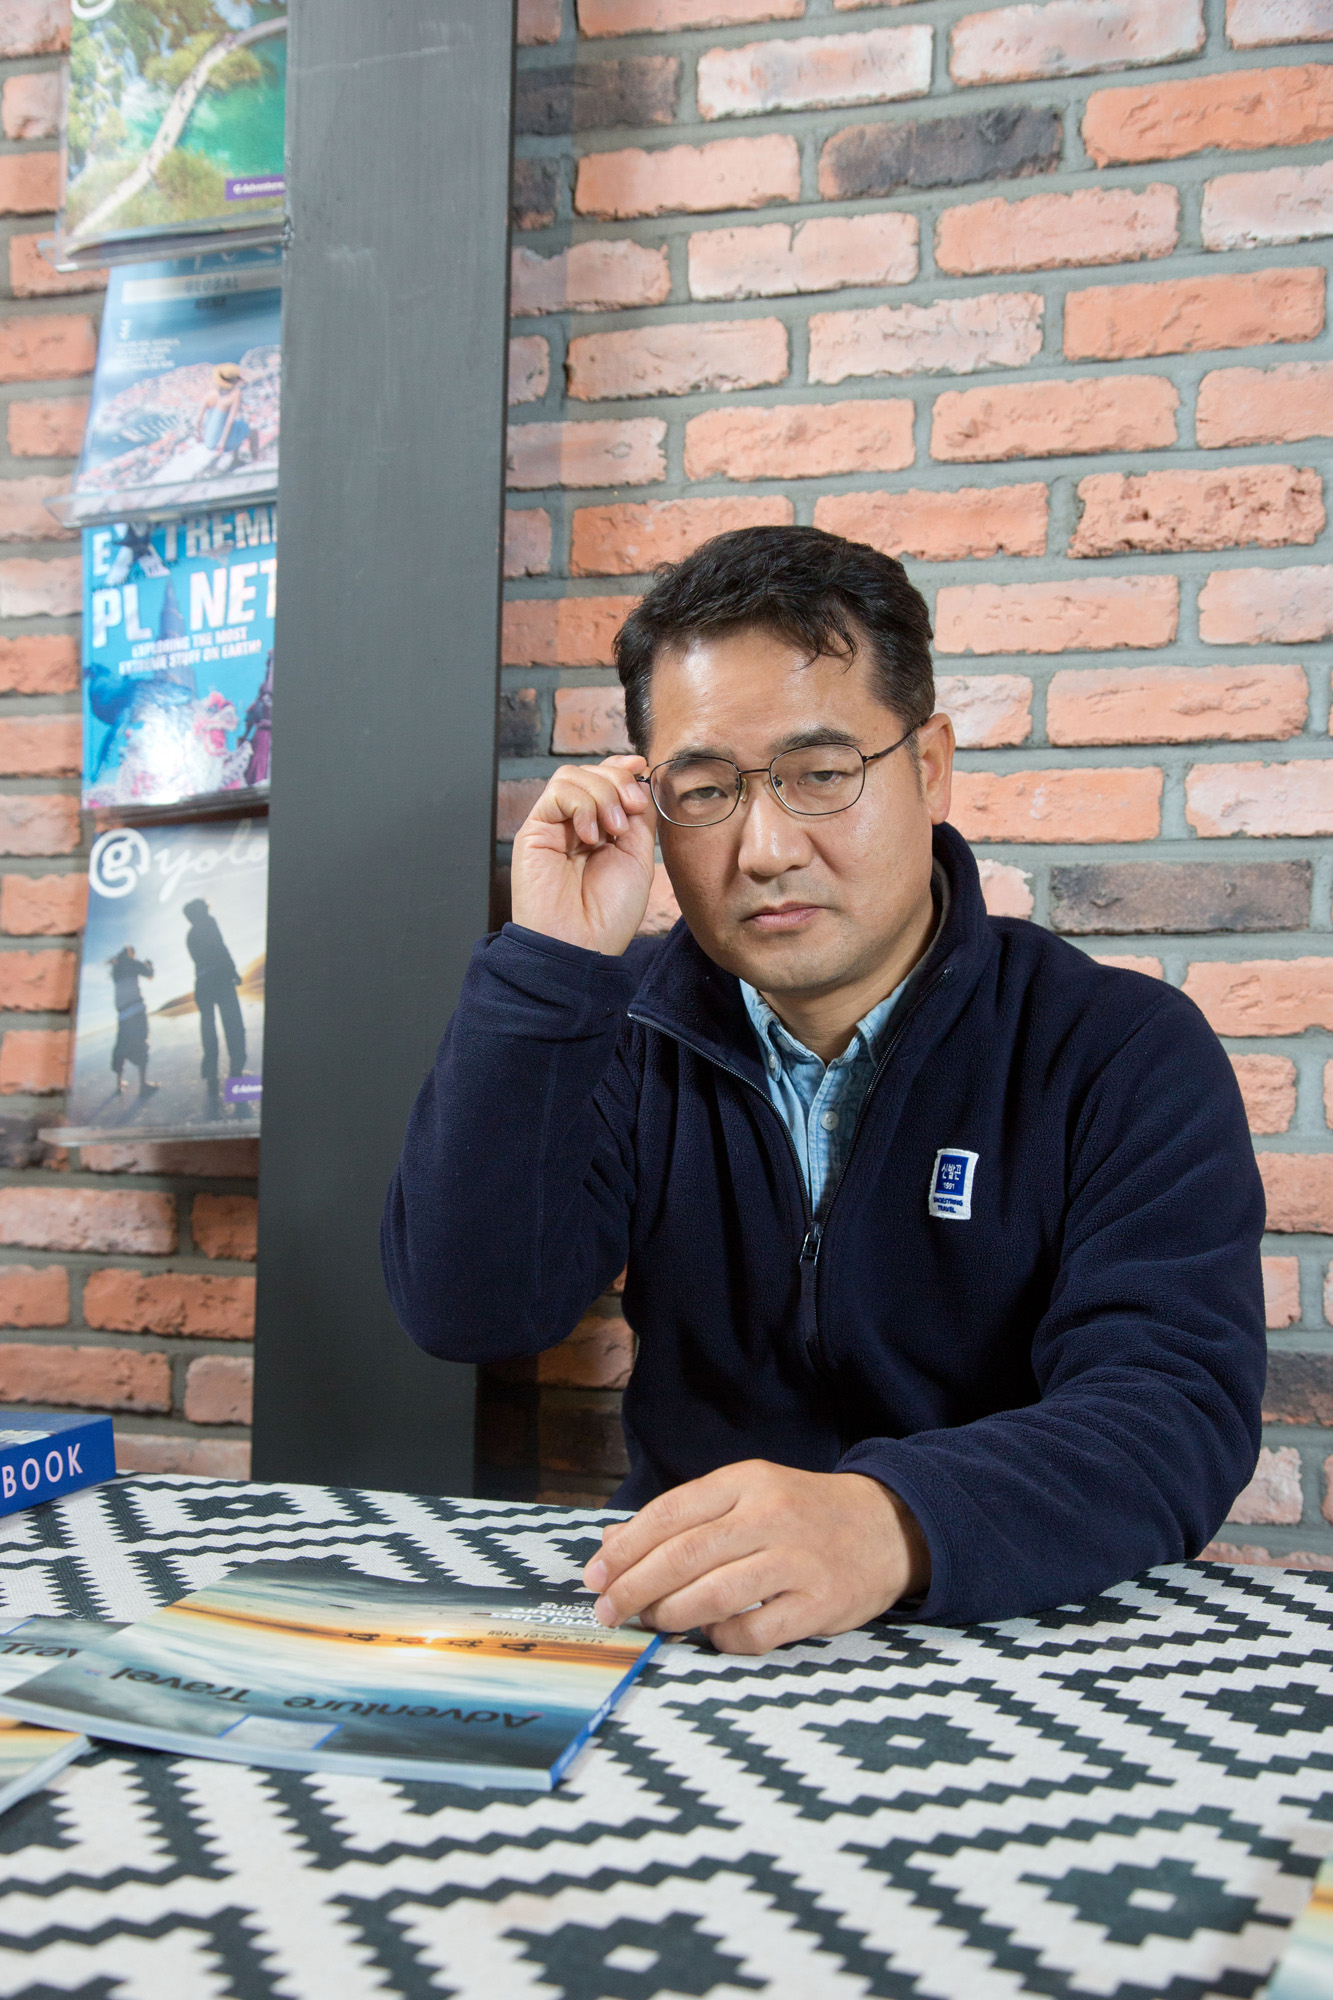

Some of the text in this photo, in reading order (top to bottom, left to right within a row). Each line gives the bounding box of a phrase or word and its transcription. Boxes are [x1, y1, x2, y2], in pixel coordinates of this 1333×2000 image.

[92, 506, 277, 587] EXTREM
[118, 654, 168, 676] EXTREME
[168, 648, 202, 668] STUFF
[202, 645, 220, 662] ON
[131, 626, 248, 659] EXPLORING THE MOST
[1, 1442, 84, 1499] BOOK
[489, 1612, 548, 1624] Class
[109, 1666, 541, 1730] Adventure Travel
